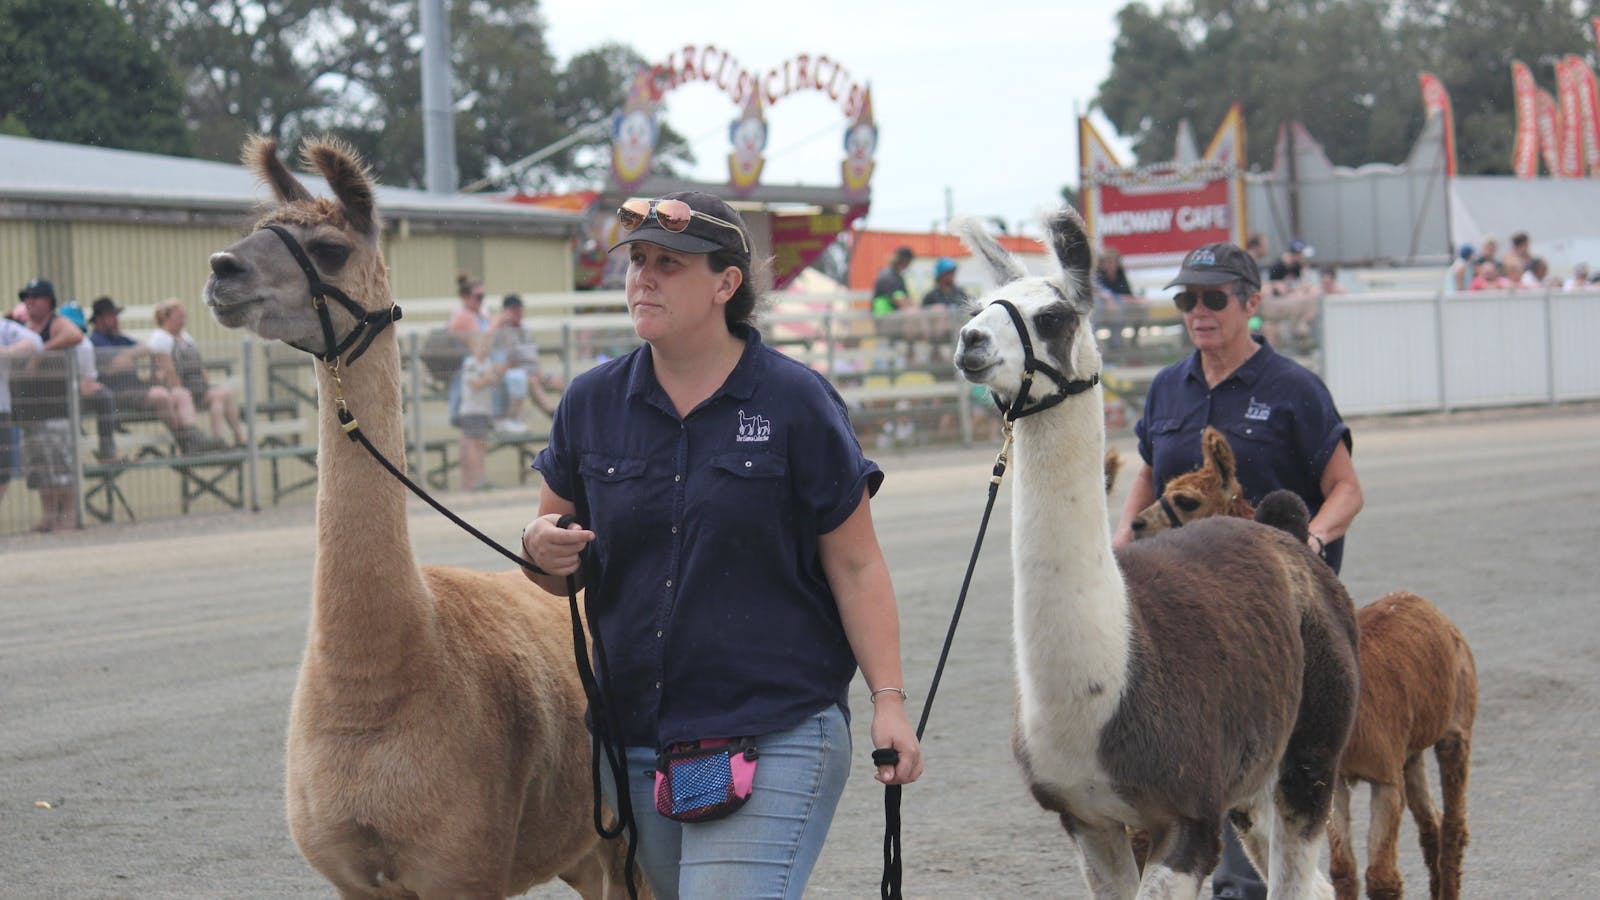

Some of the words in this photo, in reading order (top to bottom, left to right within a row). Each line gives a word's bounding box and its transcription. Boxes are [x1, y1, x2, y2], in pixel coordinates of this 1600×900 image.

[648, 44, 749, 104] CIRCUS
[765, 53, 861, 118] CIRCUS
[1100, 209, 1173, 235] MIDWAY
[1176, 205, 1227, 231] CAFE
